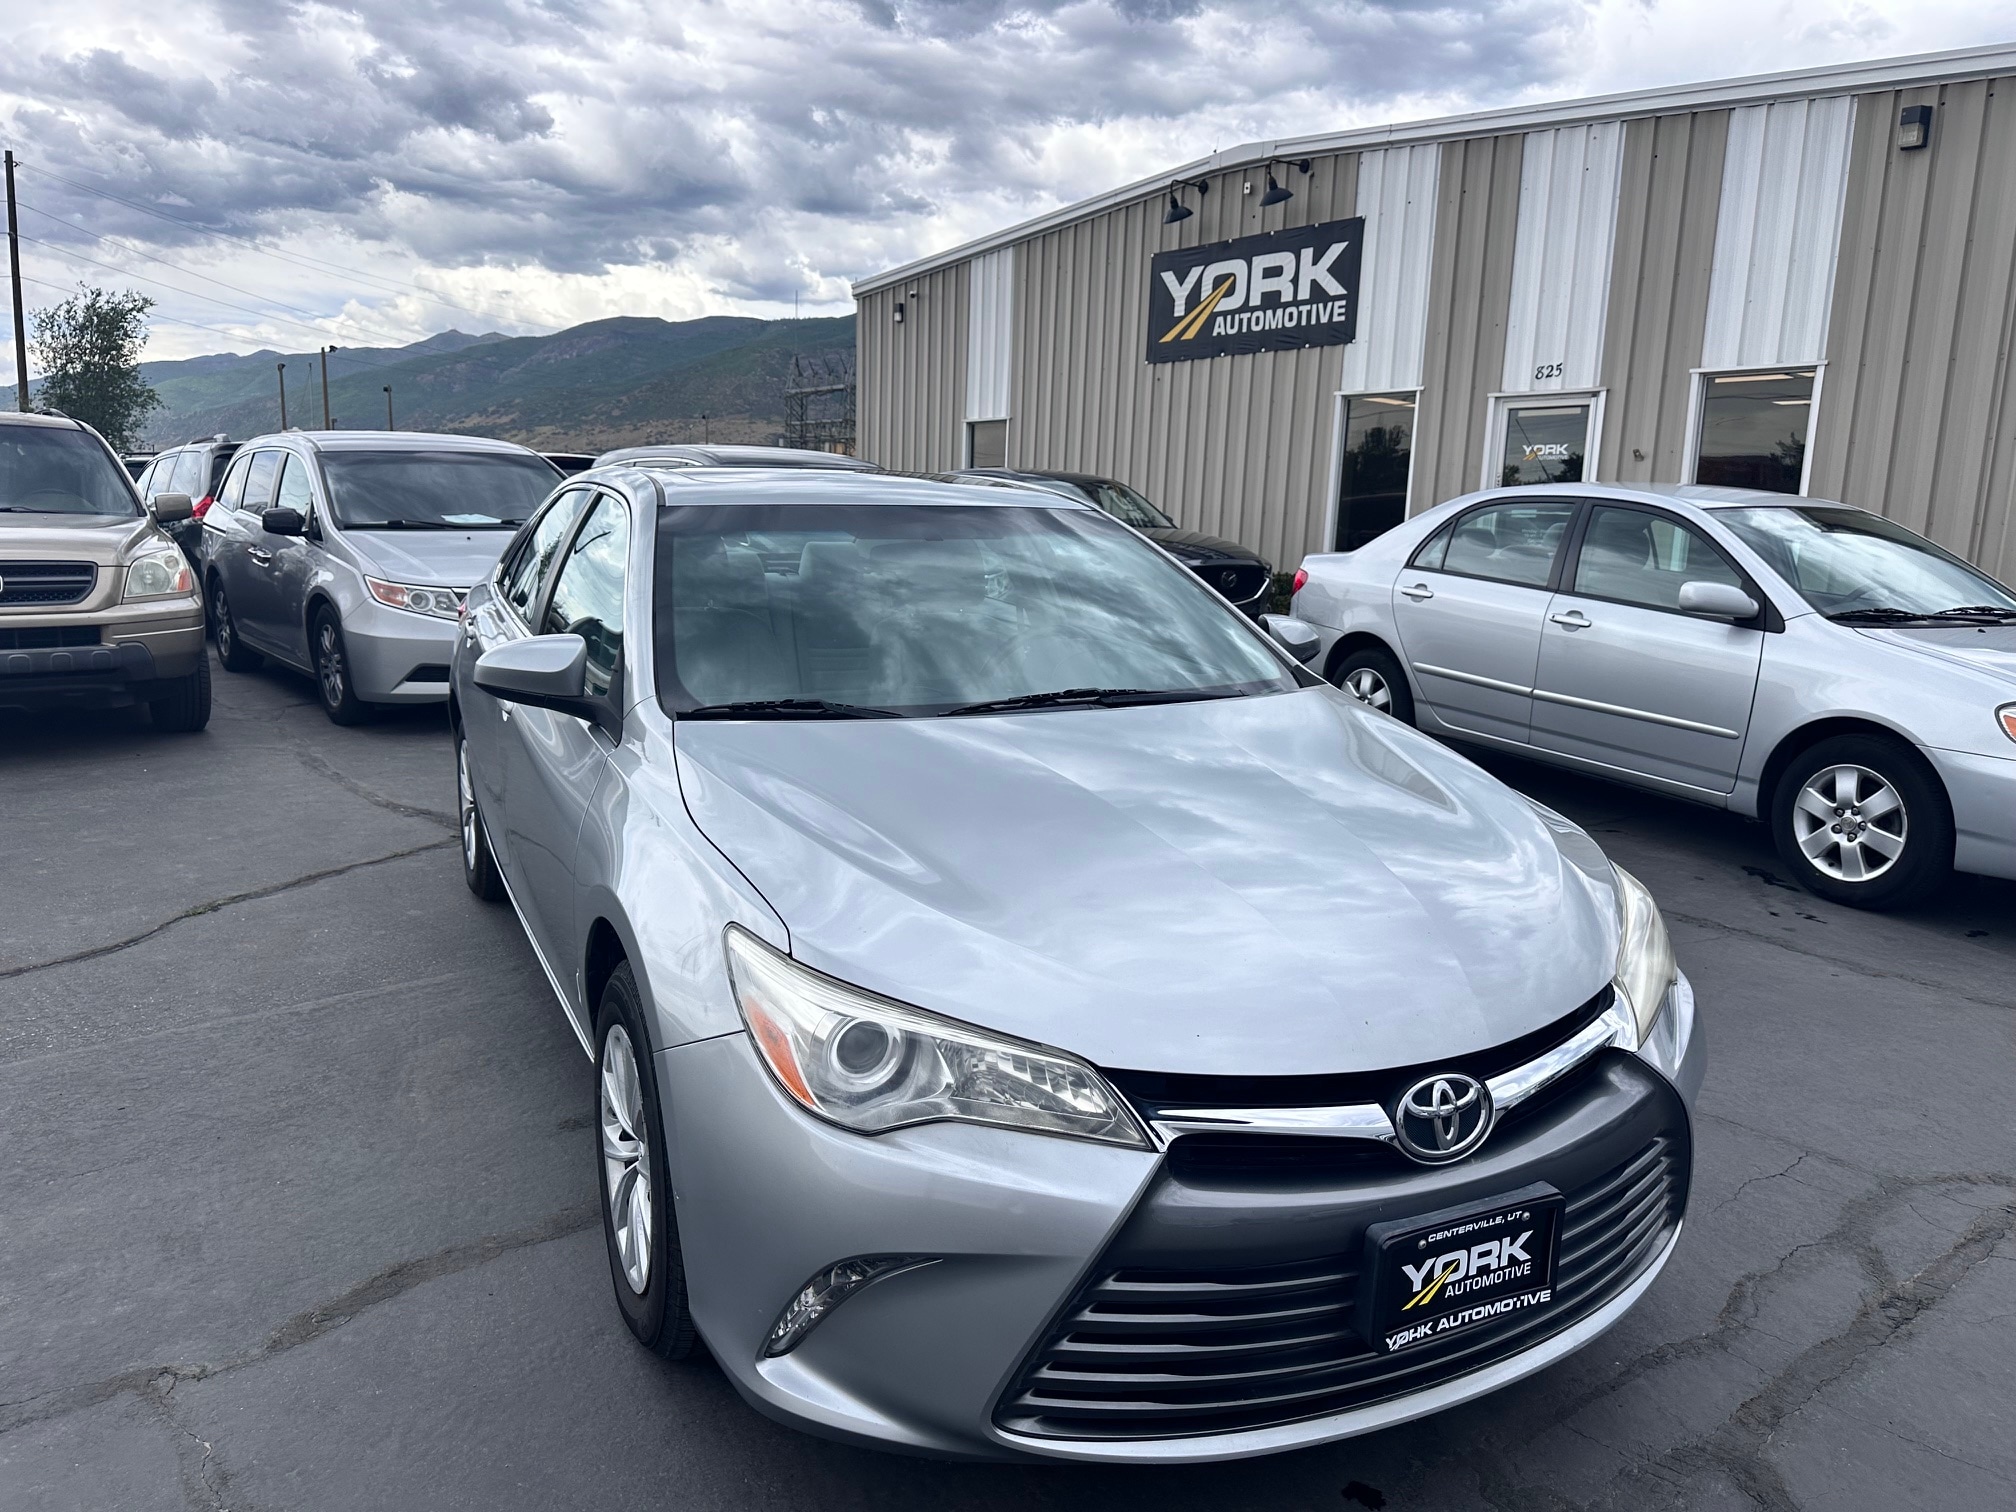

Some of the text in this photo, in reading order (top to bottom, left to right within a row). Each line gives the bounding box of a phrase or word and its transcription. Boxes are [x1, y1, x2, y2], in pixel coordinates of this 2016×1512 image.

[1160, 241, 1349, 317] YORK
[1212, 300, 1347, 336] AUTOMOTIVE
[1535, 362, 1563, 380] 825
[1522, 443, 1569, 455] YORK
[1428, 1211, 1523, 1242] CENTERVILLE, UT
[1401, 1230, 1534, 1292] YORK
[1445, 1261, 1532, 1298] AUTOMOTIVE
